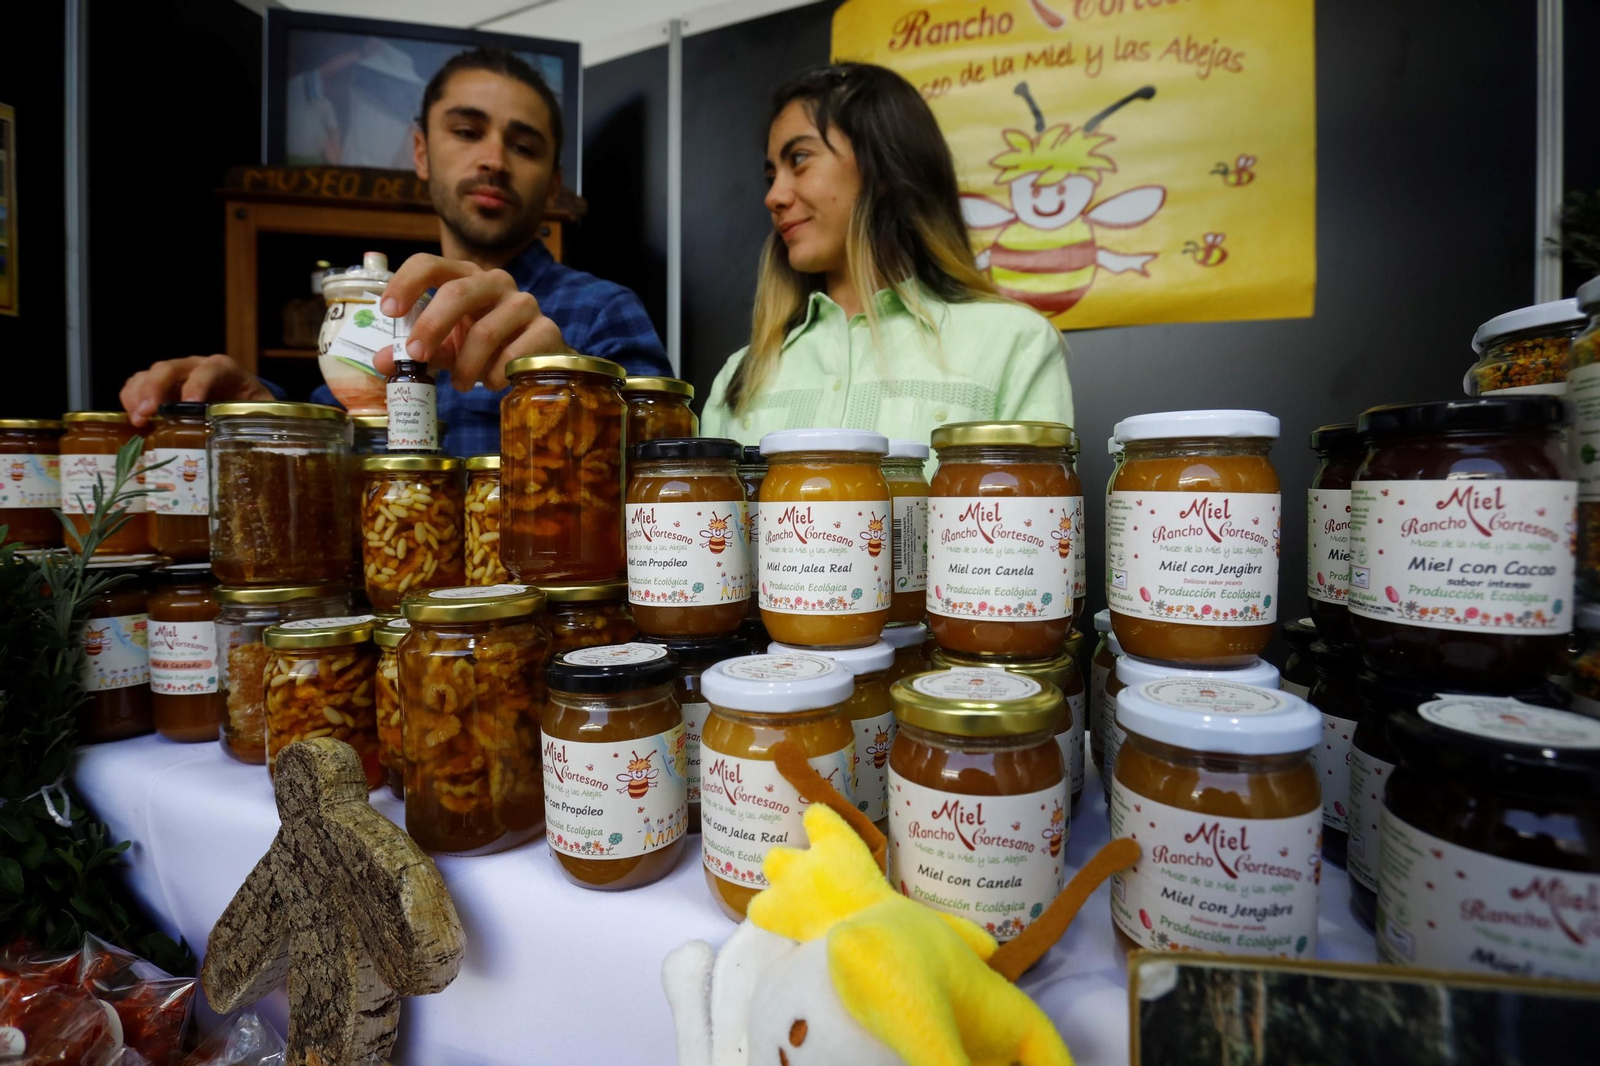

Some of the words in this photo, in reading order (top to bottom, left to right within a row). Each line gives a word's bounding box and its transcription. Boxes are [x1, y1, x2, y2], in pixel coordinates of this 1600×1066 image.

[888, 8, 1013, 50] Rancho
[919, 77, 952, 100] seo
[960, 65, 985, 86] de
[992, 54, 1014, 77] la
[1023, 41, 1076, 71] Miel
[1085, 45, 1103, 79] y
[1114, 36, 1151, 61] las
[1159, 34, 1246, 80] Abejas
[242, 167, 361, 199] MUSEO
[372, 177, 405, 200] DE
[394, 410, 411, 419] Spray
[1179, 497, 1232, 531] Miel
[1436, 485, 1506, 522] Miel
[632, 507, 657, 532] Miel
[778, 505, 814, 534] Miel
[959, 501, 1002, 532] Miel
[1324, 518, 1351, 534] Ranc
[649, 525, 693, 545] Cortesano
[765, 528, 794, 545] Rancho
[804, 525, 854, 548] Cortesano
[941, 527, 977, 546] Rancho
[991, 523, 1044, 548] Cortesano
[1153, 525, 1203, 544] Rancho
[1219, 521, 1269, 547] Cortesano
[1401, 517, 1467, 538] Rancho
[1489, 512, 1560, 543] Cortesano
[653, 546, 658, 554] y
[658, 544, 667, 552] las
[669, 544, 687, 554] Abejas
[782, 545, 788, 553] de
[795, 546, 807, 554] Miel
[811, 547, 815, 557] y
[816, 546, 826, 554] las
[827, 546, 848, 556] Abejas
[946, 545, 961, 554] Museo
[963, 546, 969, 554] de
[971, 545, 977, 554] la
[980, 546, 993, 554] Miel
[996, 548, 1001, 558] y
[1004, 546, 1015, 554] las
[1017, 546, 1039, 557] Abejas
[1159, 544, 1182, 553] Museo
[1184, 544, 1193, 553] de
[1195, 545, 1203, 554] la
[1205, 545, 1221, 554] Miel
[1224, 547, 1230, 558] y
[1232, 545, 1243, 554] las
[1244, 546, 1263, 558] Abejas
[1328, 548, 1350, 561] Mie
[1409, 539, 1439, 548] Museo
[1442, 539, 1453, 548] de
[1469, 540, 1491, 550] Miel
[636, 558, 648, 567] con
[648, 557, 688, 569] Propóleo
[766, 562, 780, 572] Miel
[781, 564, 797, 573] con
[798, 563, 825, 574] Jalea
[829, 562, 852, 572] Real
[948, 563, 968, 575] Miel
[971, 566, 991, 575] con
[995, 565, 1034, 576] Canela
[1159, 560, 1186, 572] Miel
[1190, 565, 1214, 574] con
[1215, 562, 1262, 578] Jengibre
[1407, 557, 1454, 572] Miel
[1459, 562, 1497, 574] con
[1504, 560, 1557, 576] Cacao
[653, 577, 688, 588] Ecológica
[769, 581, 805, 592] Producción
[808, 583, 847, 595] Ecológica
[946, 584, 990, 596] Producción
[994, 584, 1037, 600] Ecológica
[1446, 577, 1484, 588] sabor
[1487, 579, 1532, 589] intenso
[1158, 585, 1216, 599] Producción
[1220, 587, 1261, 602] Ecológica
[1408, 585, 1484, 600] Producción
[1490, 589, 1549, 606] Ecológica
[155, 625, 177, 641] Miel
[544, 741, 568, 772] Miel
[561, 765, 609, 791] Cortesano
[709, 758, 743, 793] Miel
[570, 788, 580, 796] las
[581, 788, 603, 801] Abejas
[734, 785, 790, 814] Cortesano
[561, 801, 604, 818] Propóleo
[738, 811, 744, 821] y
[745, 810, 757, 820] las
[757, 812, 783, 825] Abejas
[931, 800, 985, 837] Miel
[566, 823, 604, 839] Ecológica
[712, 821, 727, 834] con
[728, 826, 756, 841] Jalea
[761, 832, 789, 842] Real
[908, 821, 955, 842] Rancho
[972, 828, 1035, 853] Cortesano
[1184, 822, 1251, 864] Miel
[914, 841, 936, 855] Museo
[936, 849, 945, 858] de
[947, 850, 955, 860] la
[957, 852, 975, 864] Miel
[978, 857, 985, 868] y
[988, 854, 1000, 864] las
[1004, 853, 1028, 867] Abejas
[1153, 845, 1214, 868] Rancho
[1234, 853, 1303, 882] Cortesano
[917, 864, 944, 882] Miel
[947, 874, 971, 888] con
[976, 876, 1022, 889] Canela
[1190, 876, 1201, 886] de
[913, 885, 970, 911] Producción
[974, 901, 1026, 917] Ecológica
[1160, 886, 1195, 907] Miel
[1198, 900, 1228, 915] con
[1229, 902, 1294, 923] Jengibre
[1160, 914, 1232, 945] Producción
